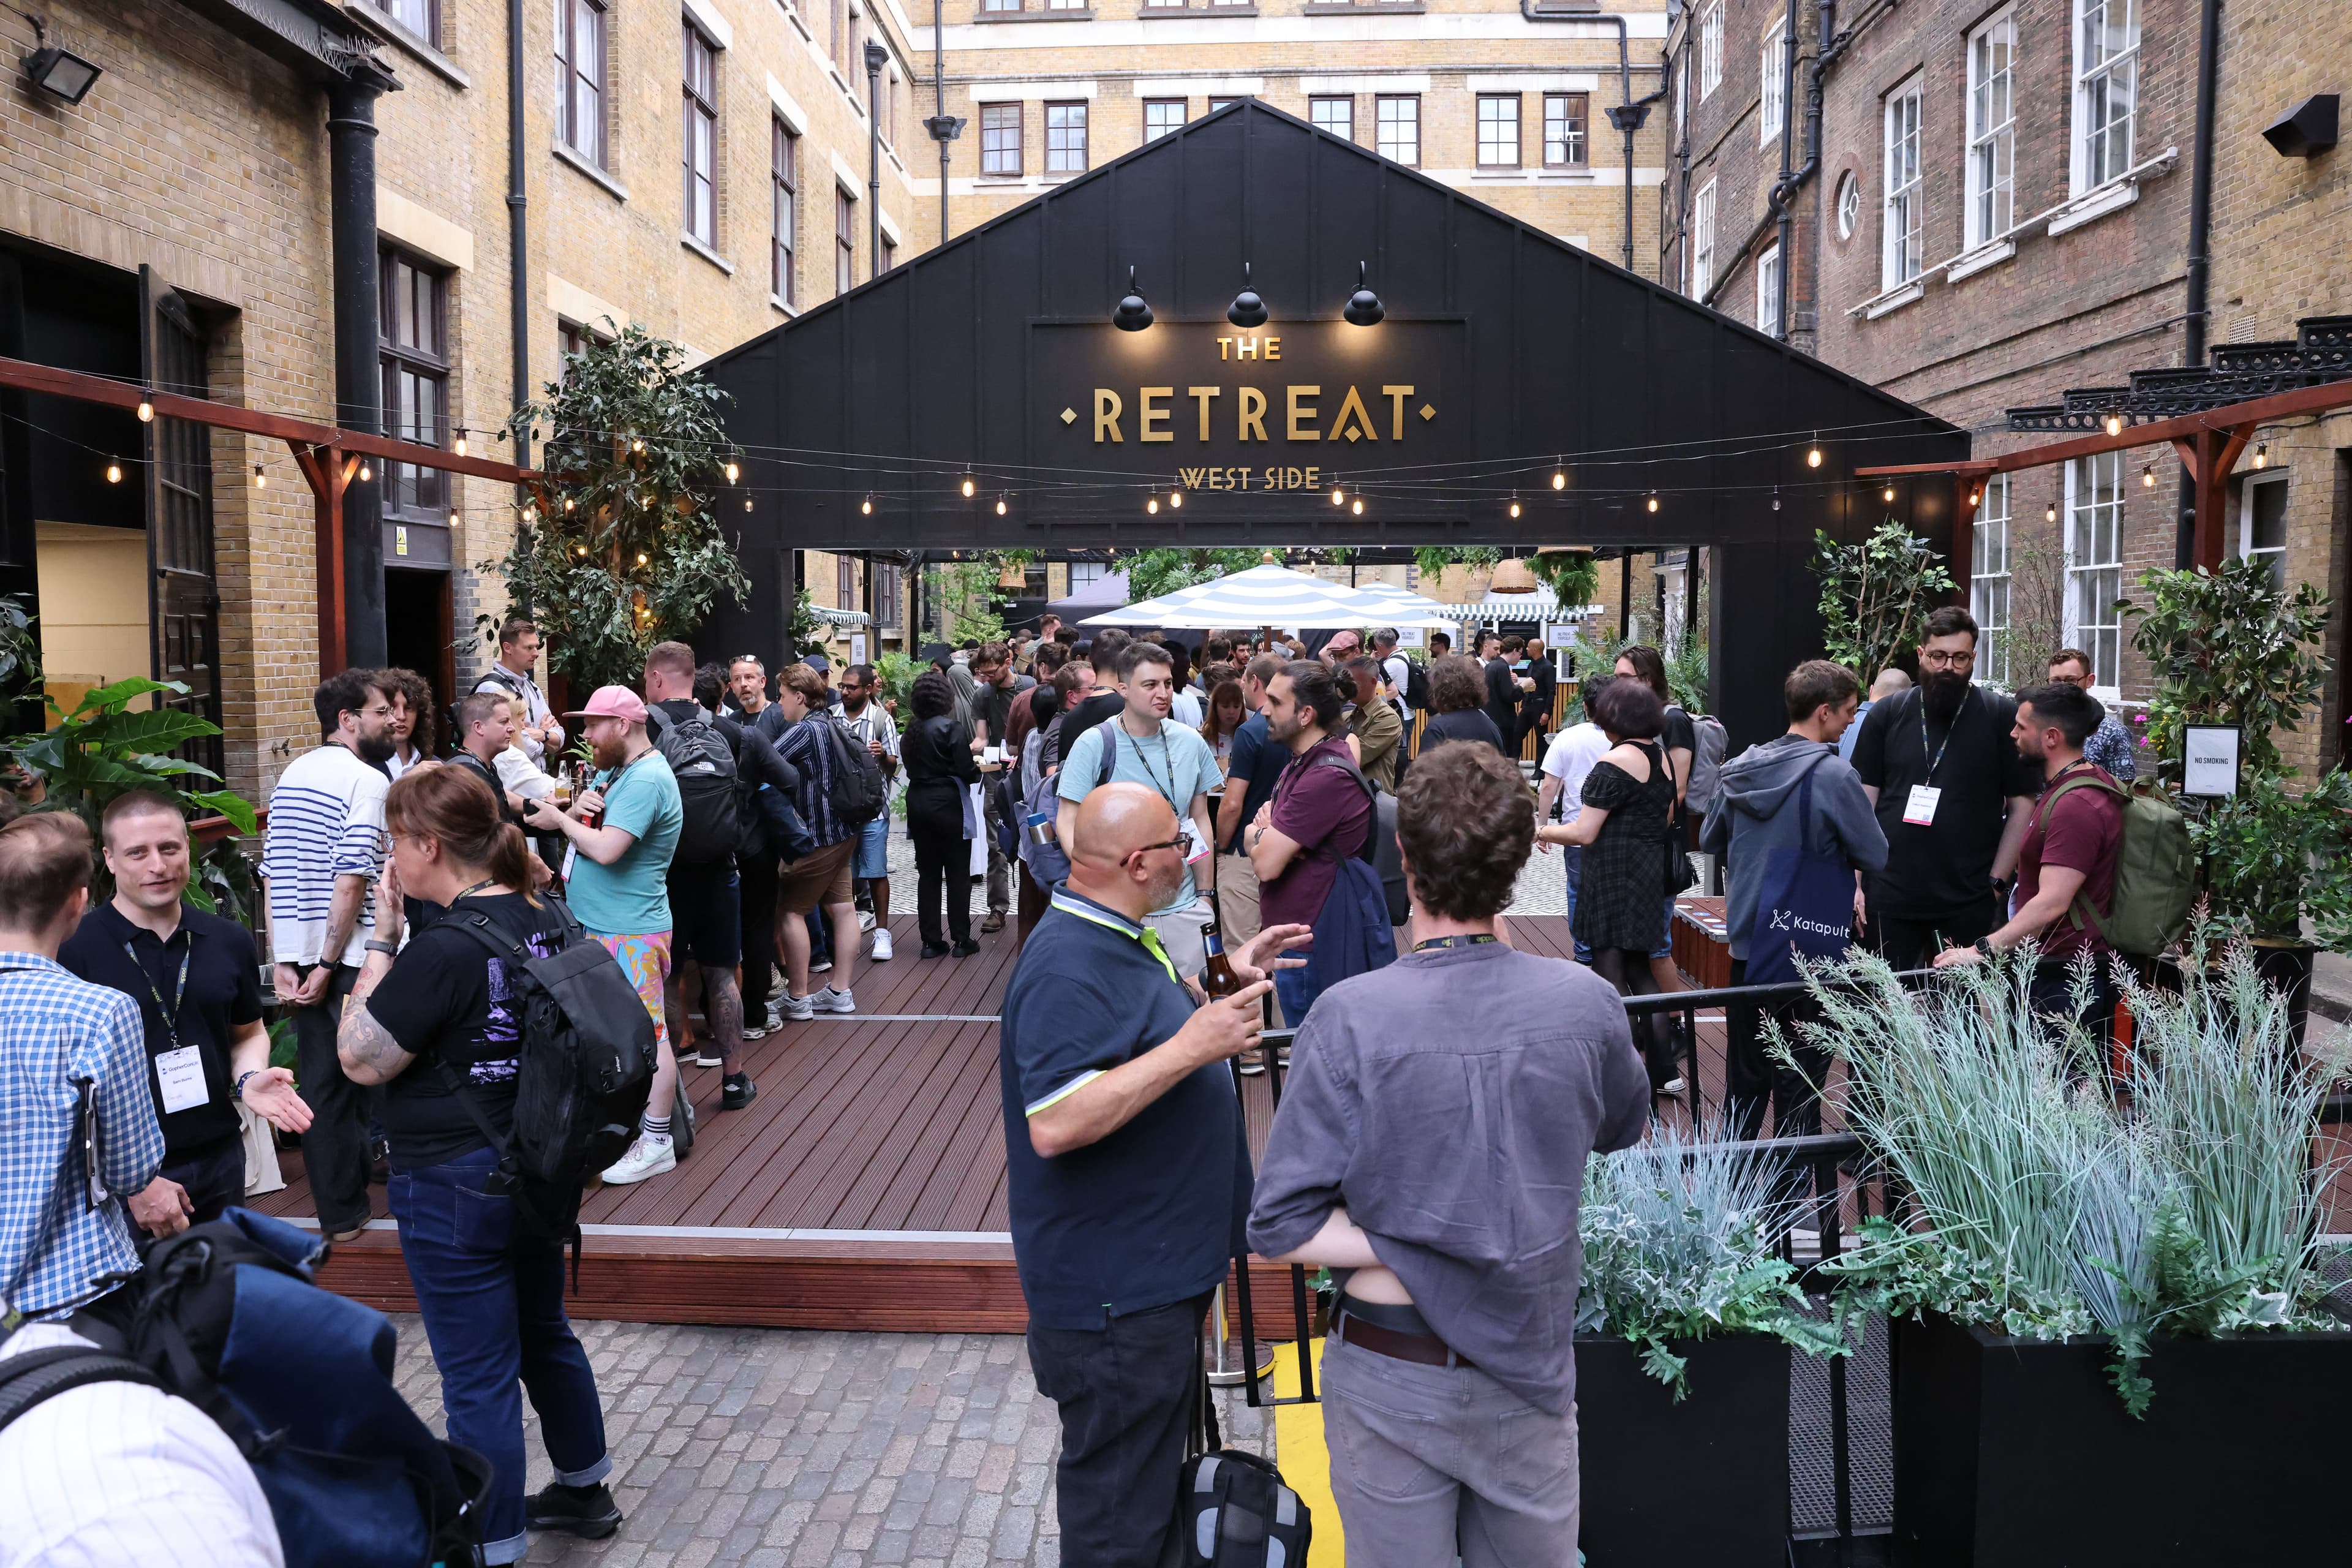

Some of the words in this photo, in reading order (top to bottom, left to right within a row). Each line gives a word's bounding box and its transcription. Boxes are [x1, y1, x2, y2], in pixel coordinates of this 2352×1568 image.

[1217, 337, 1281, 360] THE
[1094, 385, 1414, 442] RETREAT
[1179, 467, 1251, 489] WEST
[1265, 467, 1320, 489] SIDE
[458, 888, 475, 900] paddle
[1794, 916, 1850, 938] Katapult
